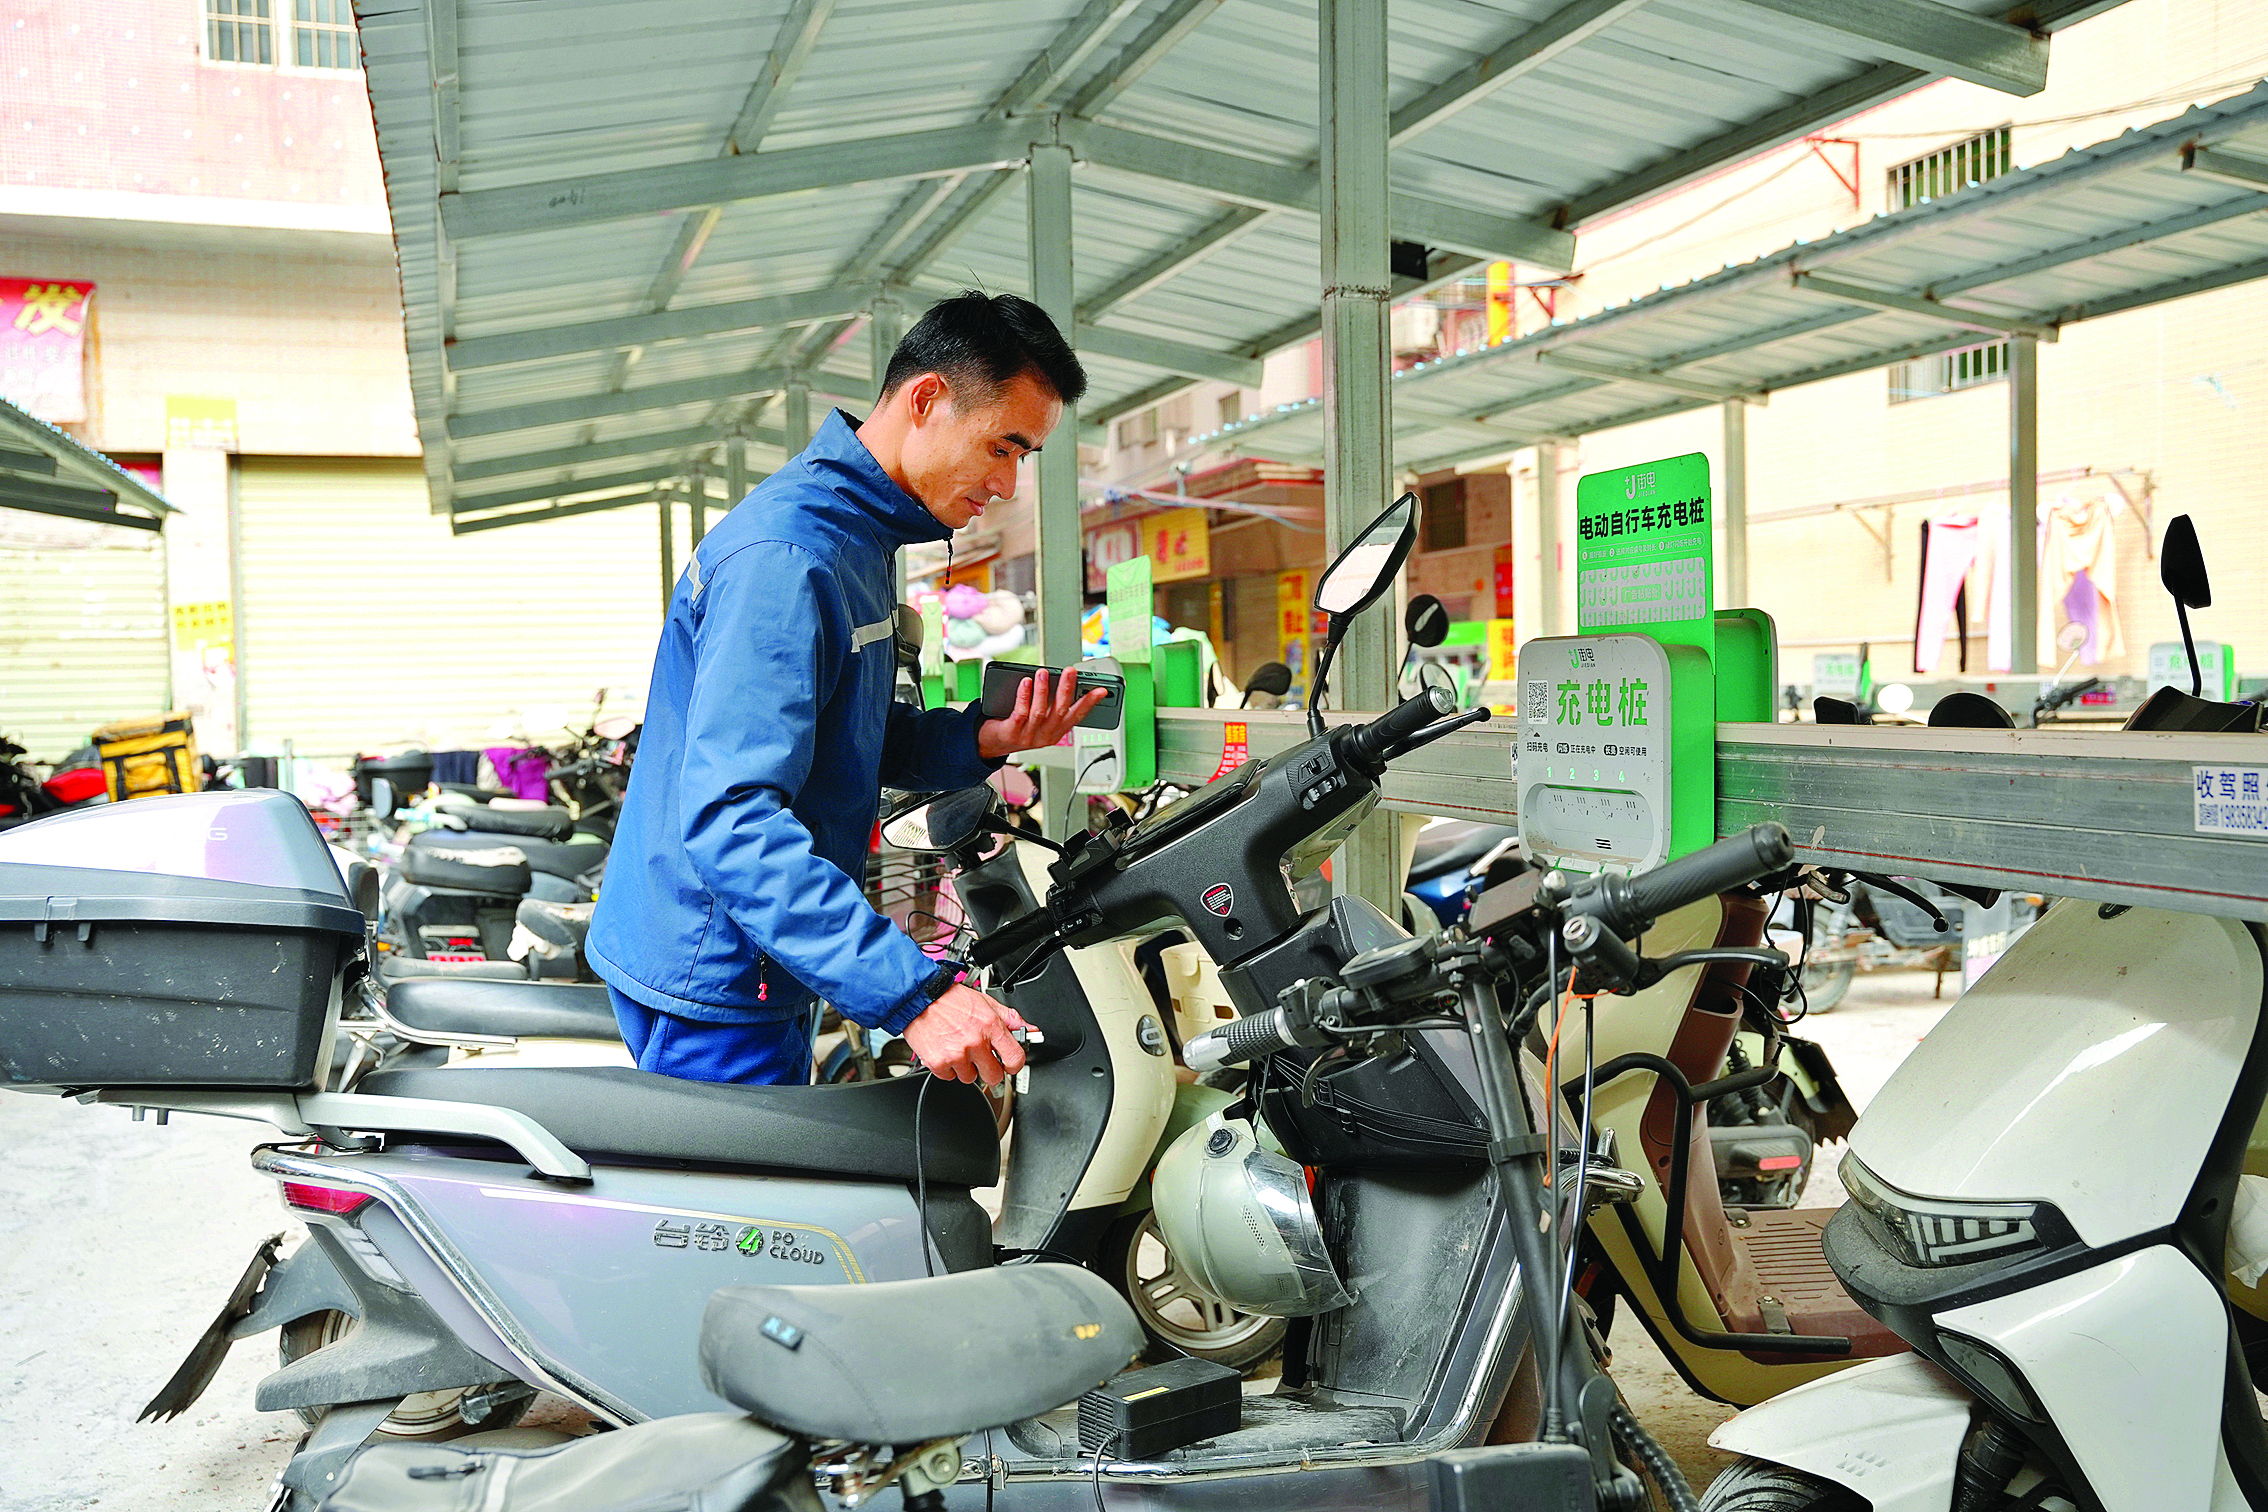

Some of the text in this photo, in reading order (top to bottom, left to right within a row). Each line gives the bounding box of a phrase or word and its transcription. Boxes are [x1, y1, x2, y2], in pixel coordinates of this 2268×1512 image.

[1638, 471, 1656, 490] 街电
[1638, 490, 1657, 498] JIEDIAN
[1579, 496, 1705, 540] 电动自行车充电桩
[1578, 648, 1595, 662] 街电
[1556, 677, 1648, 727] 充电桩
[1526, 741, 1549, 753] 扫码充电
[1570, 744, 1596, 755] 正在充电中
[1619, 746, 1648, 757] 空闲可使用
[1546, 766, 1626, 783] 1 2 3 4
[2196, 769, 2268, 801] 收驾照
[654, 1218, 730, 1251] 台铃
[769, 1244, 825, 1265] CLOUD
